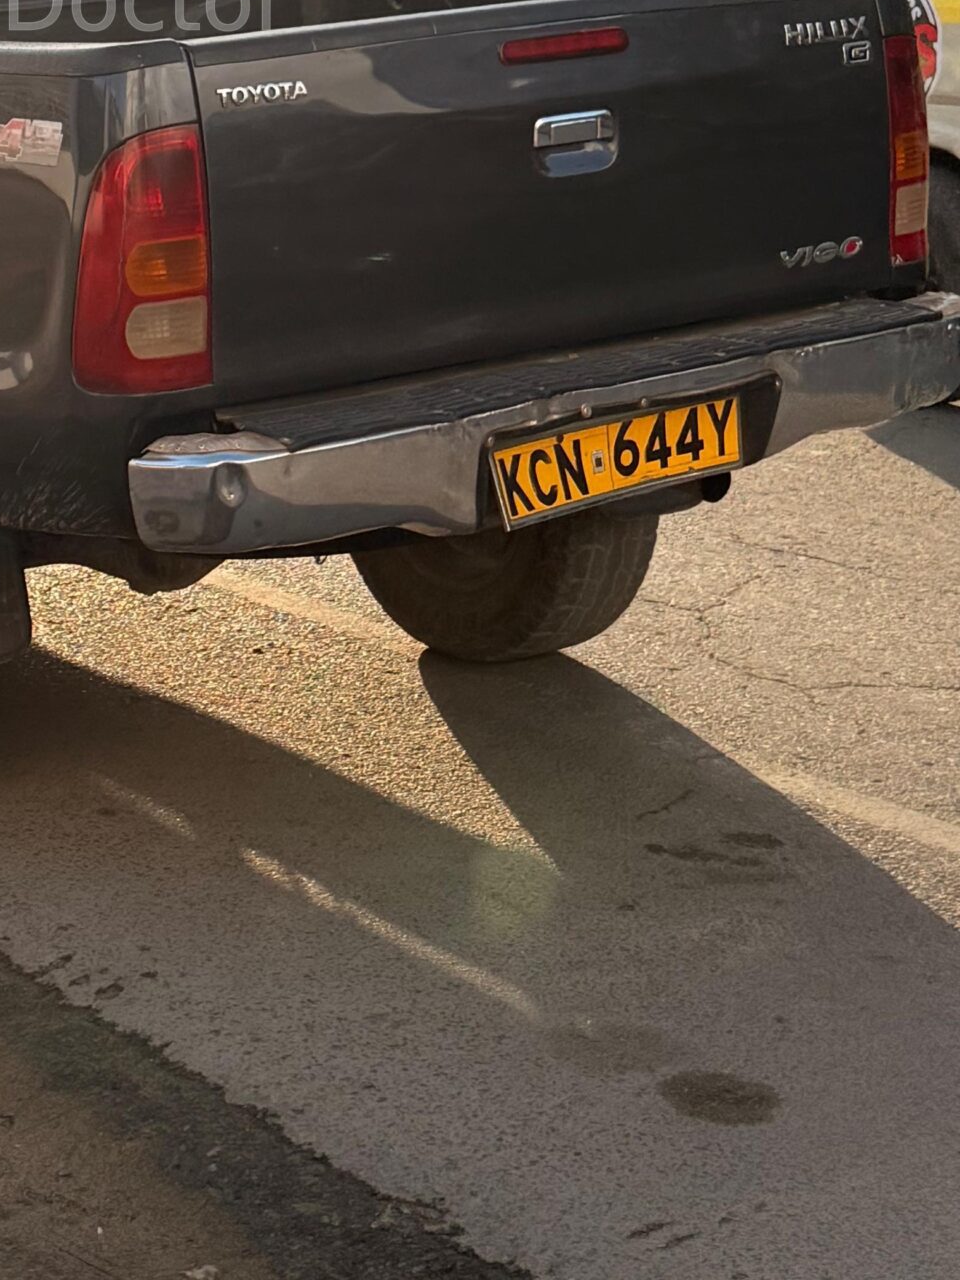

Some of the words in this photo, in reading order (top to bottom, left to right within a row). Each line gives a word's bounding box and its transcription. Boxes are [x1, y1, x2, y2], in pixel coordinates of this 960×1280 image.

[783, 16, 866, 46] HILUX
[216, 80, 308, 108] TOYOTA
[780, 236, 863, 268] VIGO
[498, 438, 590, 517] KCN
[613, 398, 735, 477] 644Y
